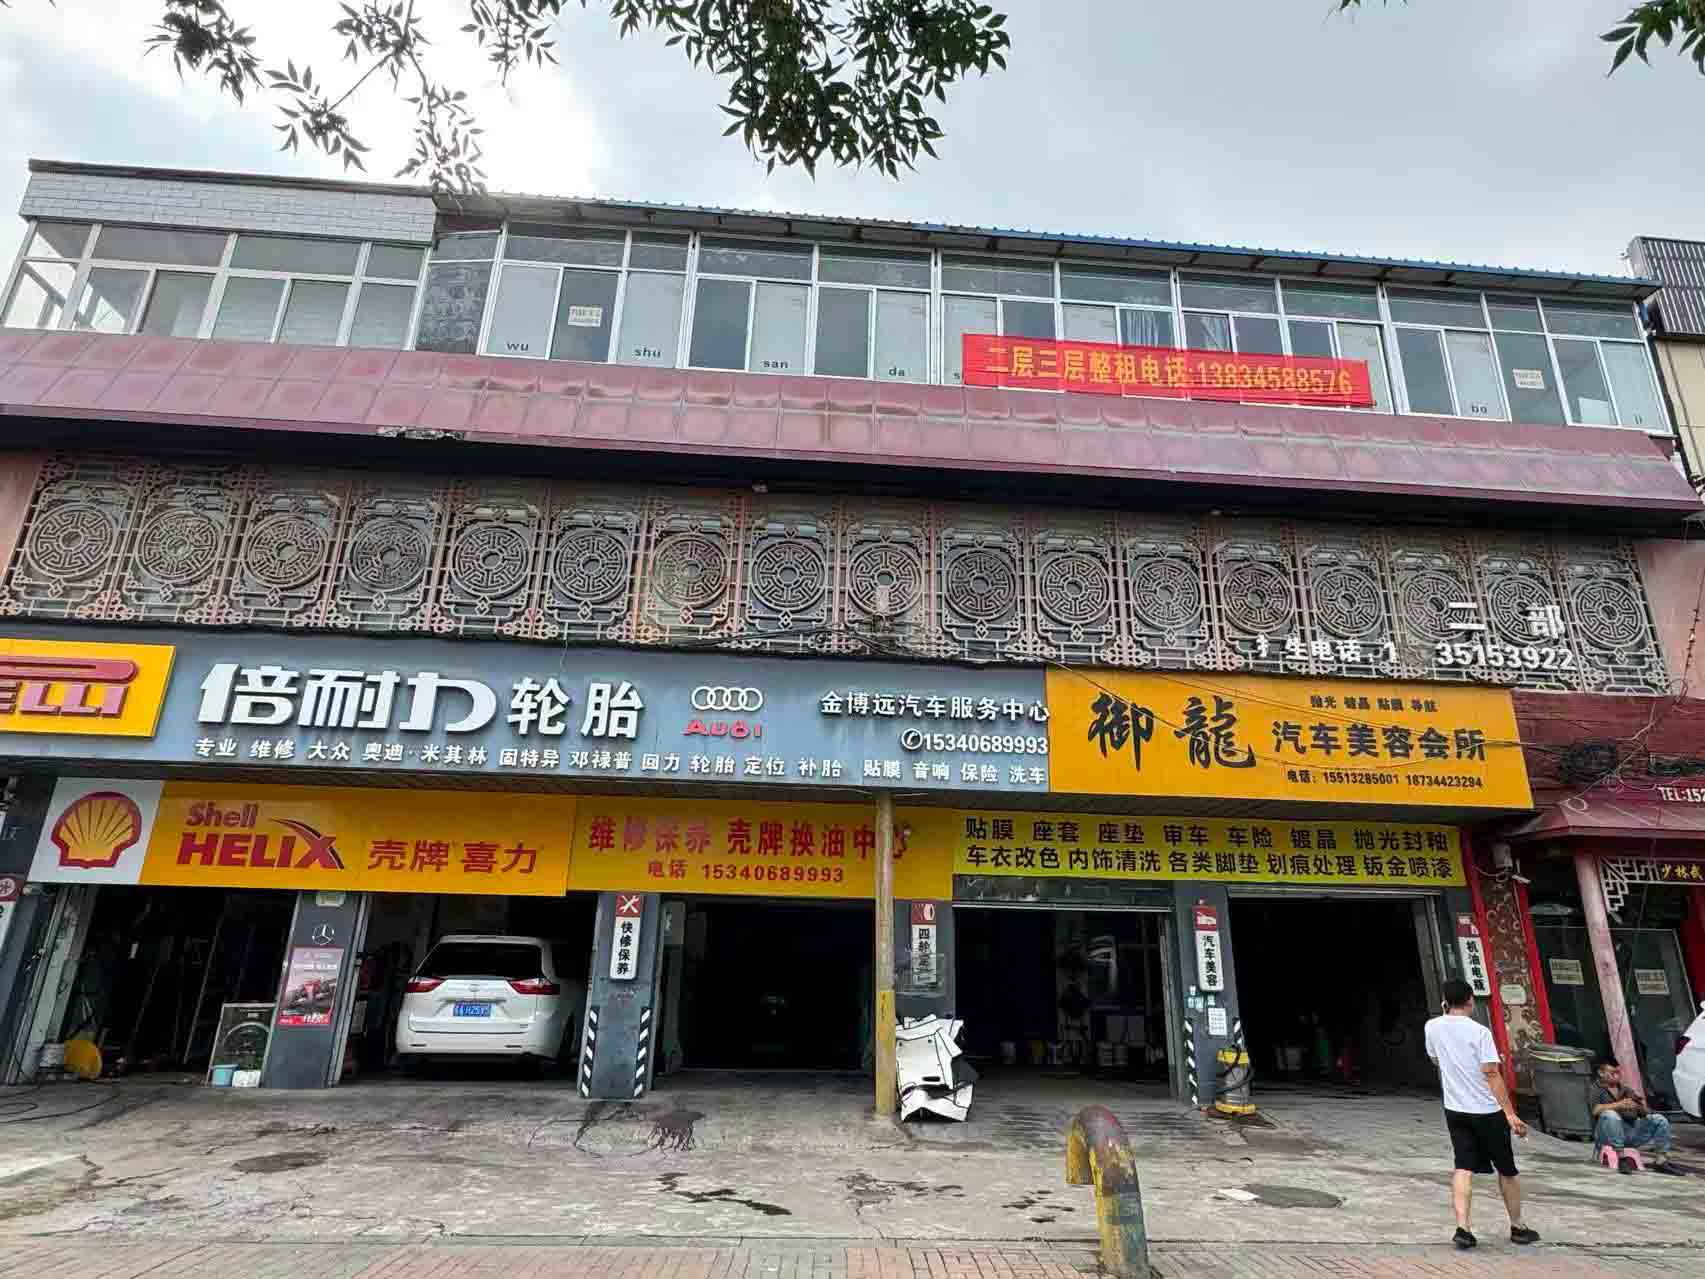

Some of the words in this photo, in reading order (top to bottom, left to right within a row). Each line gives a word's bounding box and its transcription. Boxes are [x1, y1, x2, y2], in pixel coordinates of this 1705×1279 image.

[507, 342, 529, 352] wu
[634, 346, 661, 358] shu
[762, 360, 789, 369] san
[888, 366, 906, 377] da
[198, 662, 498, 733] 倍耐力
[507, 677, 644, 739] 轮胎
[820, 689, 1050, 722] 金博远汽车服务中心
[922, 732, 1048, 755] 15340689993
[1271, 719, 1487, 762] 汽车美容会所
[194, 738, 238, 758] 专业
[249, 739, 296, 760] 维修
[307, 740, 351, 761] 大众
[499, 748, 560, 770] 固特异
[568, 750, 633, 771] 邓禄普
[641, 753, 681, 772] 回力
[690, 755, 736, 774] 轮胎
[743, 755, 785, 776] 定位
[798, 759, 843, 778] 补胎
[863, 759, 902, 779] 贴膜
[912, 762, 950, 780] 音响
[960, 762, 999, 783] 保险
[1009, 765, 1047, 785] 洗车
[185, 801, 259, 829] Shell
[175, 829, 345, 870] HELIX
[965, 817, 1014, 841] 贴膜
[1032, 820, 1081, 843] 座套
[1097, 822, 1145, 844] 座垫
[1162, 823, 1209, 847] 审车
[1226, 826, 1273, 849] 车险
[1289, 828, 1337, 850] 镀晶
[702, 862, 844, 882] 15340689993
[966, 844, 1061, 870] 车衣改色
[1068, 847, 1161, 872] 内饰清洗
[1167, 850, 1260, 875] 各类脚垫
[1266, 853, 1356, 877] 划痕处理
[1363, 855, 1453, 879] 钣金喷漆
[616, 920, 633, 975] 快修保养
[1202, 935, 1218, 987] 汽车美容
